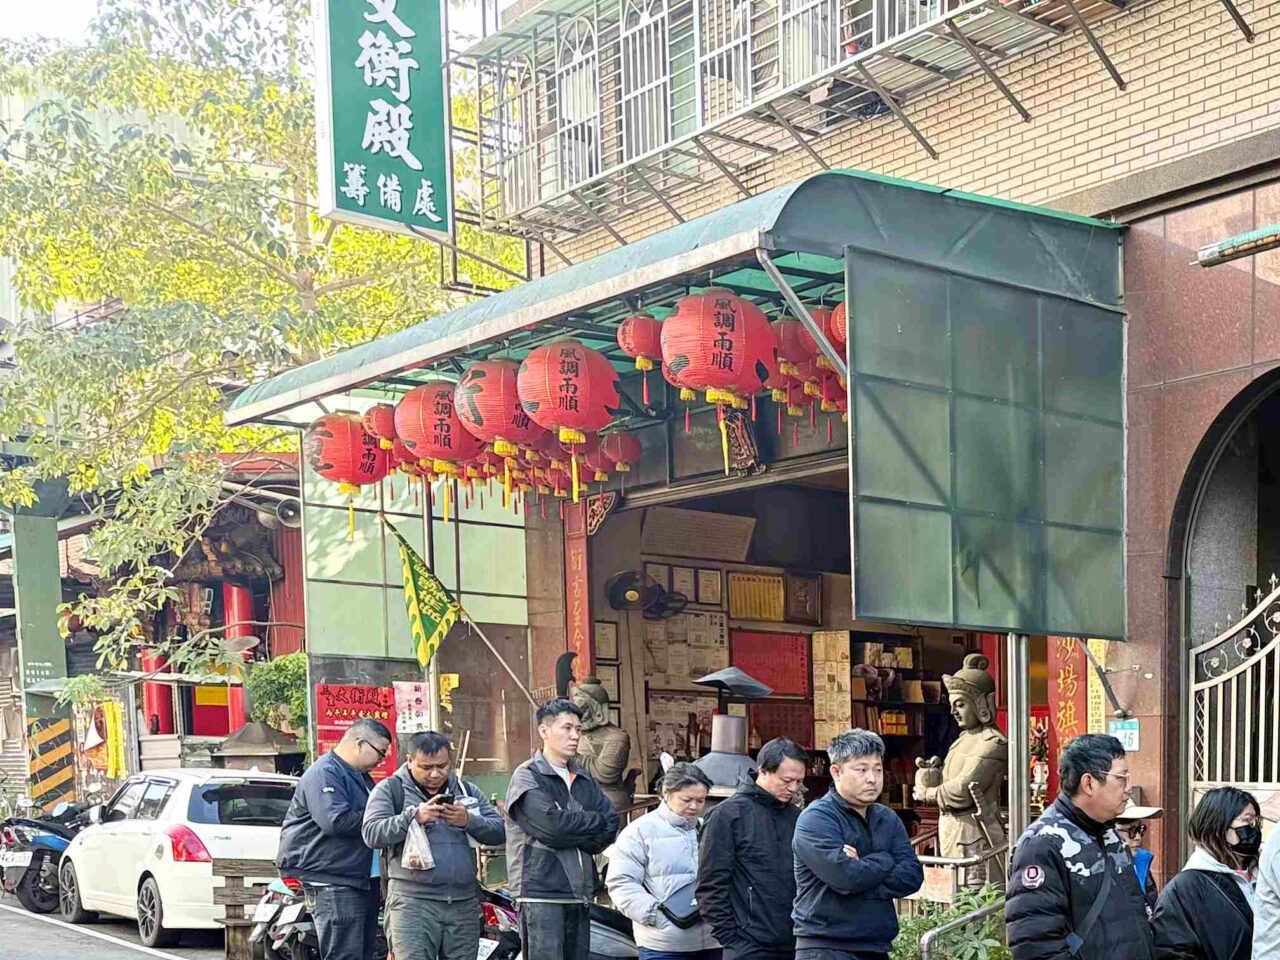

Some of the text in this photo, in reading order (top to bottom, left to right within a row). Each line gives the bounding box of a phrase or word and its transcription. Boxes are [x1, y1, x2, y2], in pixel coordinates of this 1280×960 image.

[340, 161, 443, 223] 籌備處
[711, 299, 736, 372] 風調雨順
[557, 349, 580, 414] 風調雨順
[358, 422, 378, 475] 調雨順
[433, 389, 453, 450] 風調雨順
[1056, 636, 1079, 757] 沙場旗
